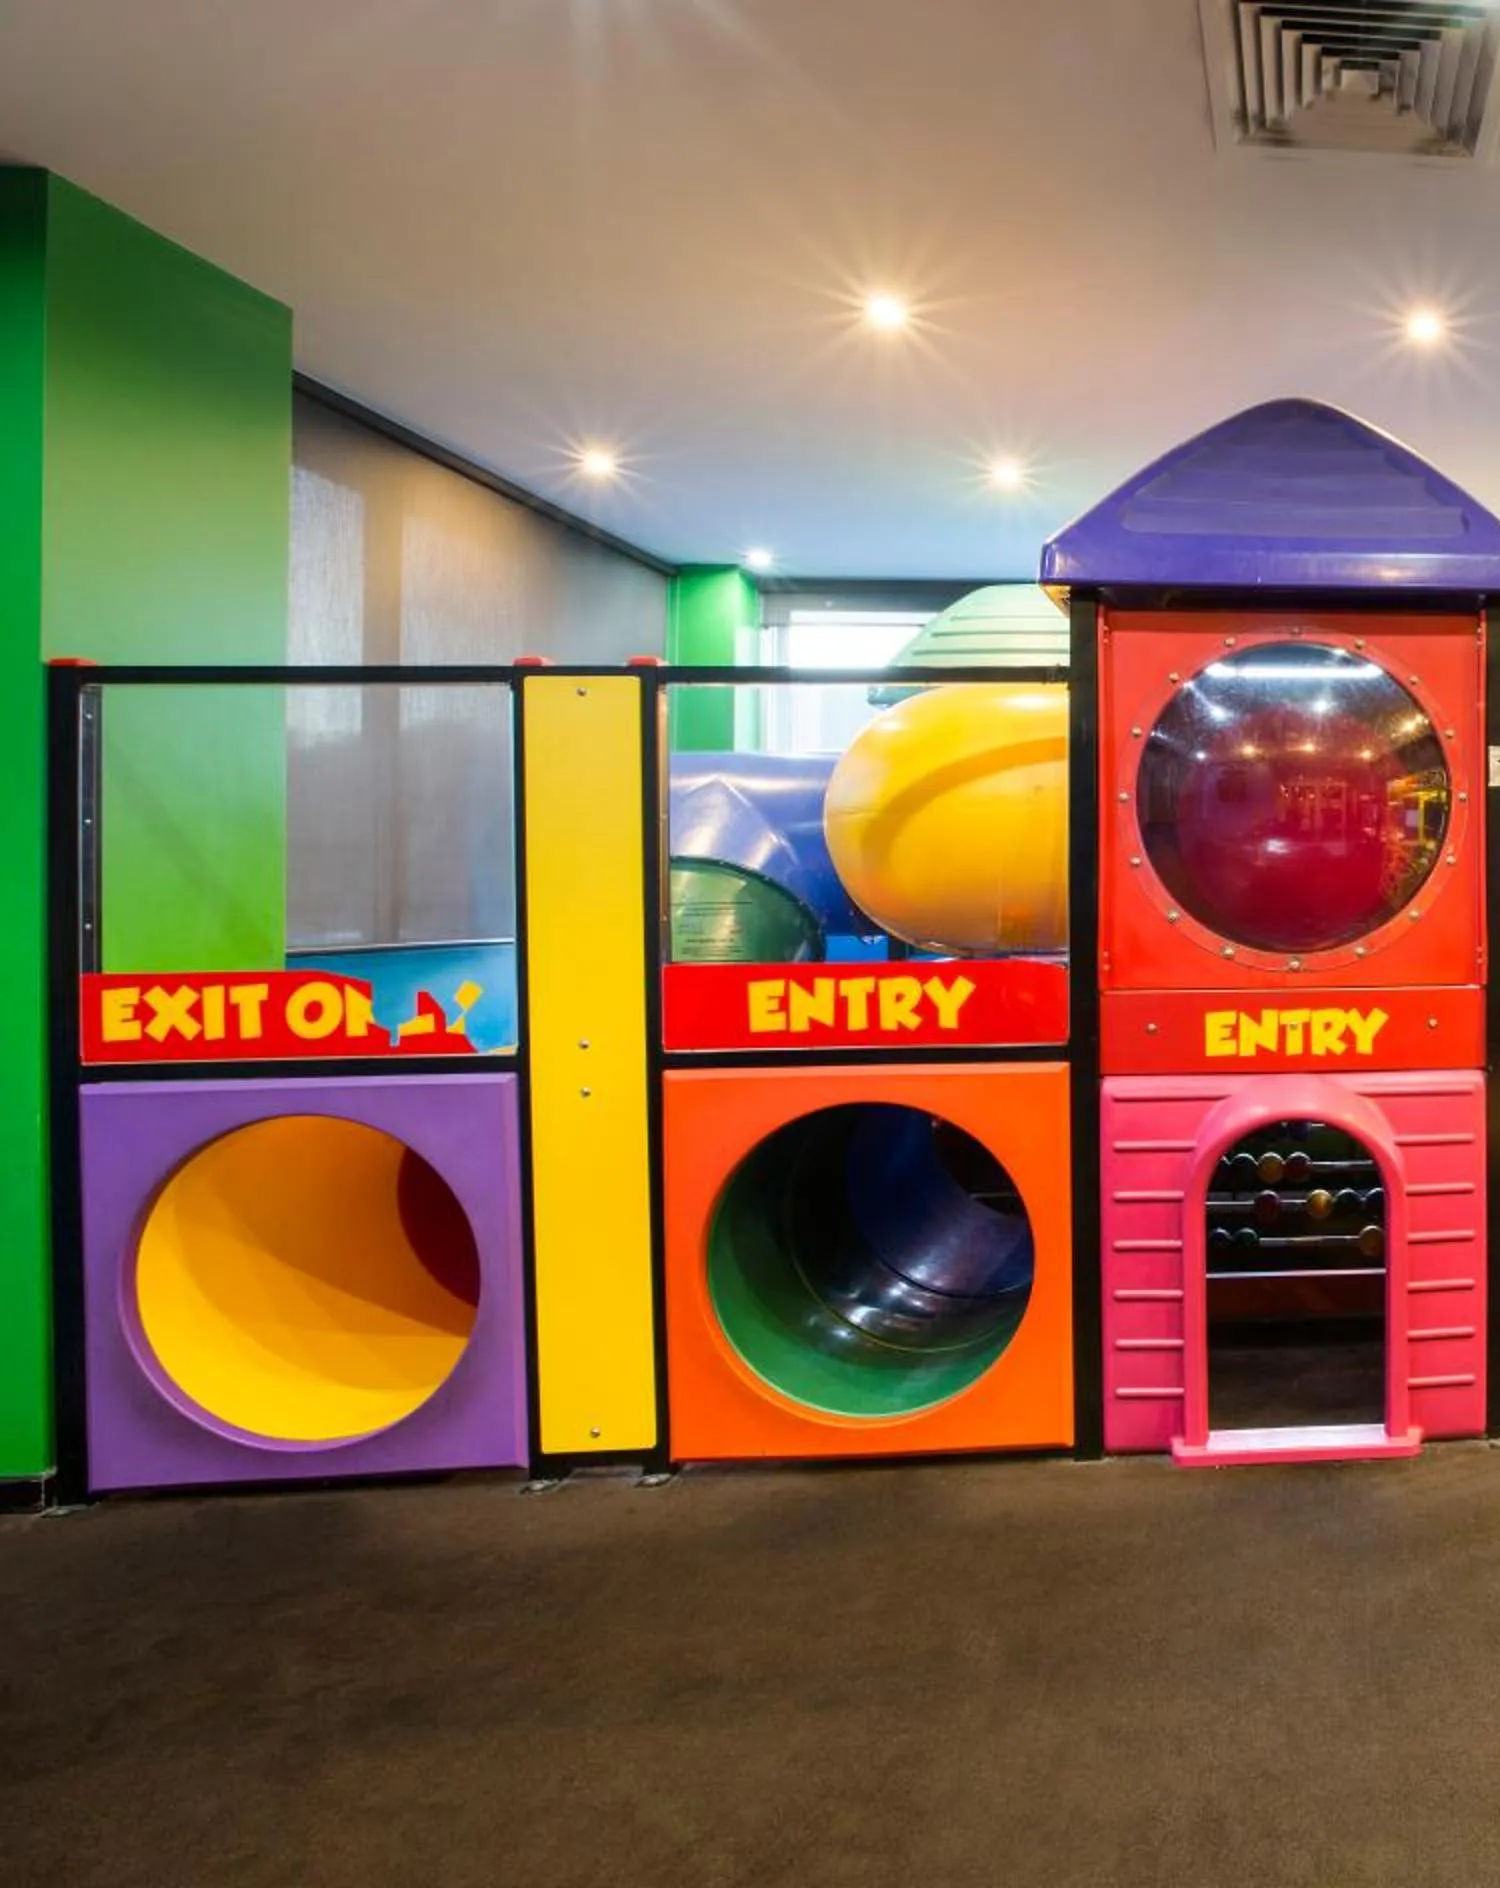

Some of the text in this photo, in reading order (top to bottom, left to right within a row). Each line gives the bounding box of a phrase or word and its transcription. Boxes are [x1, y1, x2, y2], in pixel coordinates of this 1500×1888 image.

[101, 984, 269, 1042] EXIT
[748, 976, 976, 1032] ENTRY
[1205, 1009, 1388, 1058] ENTRY
